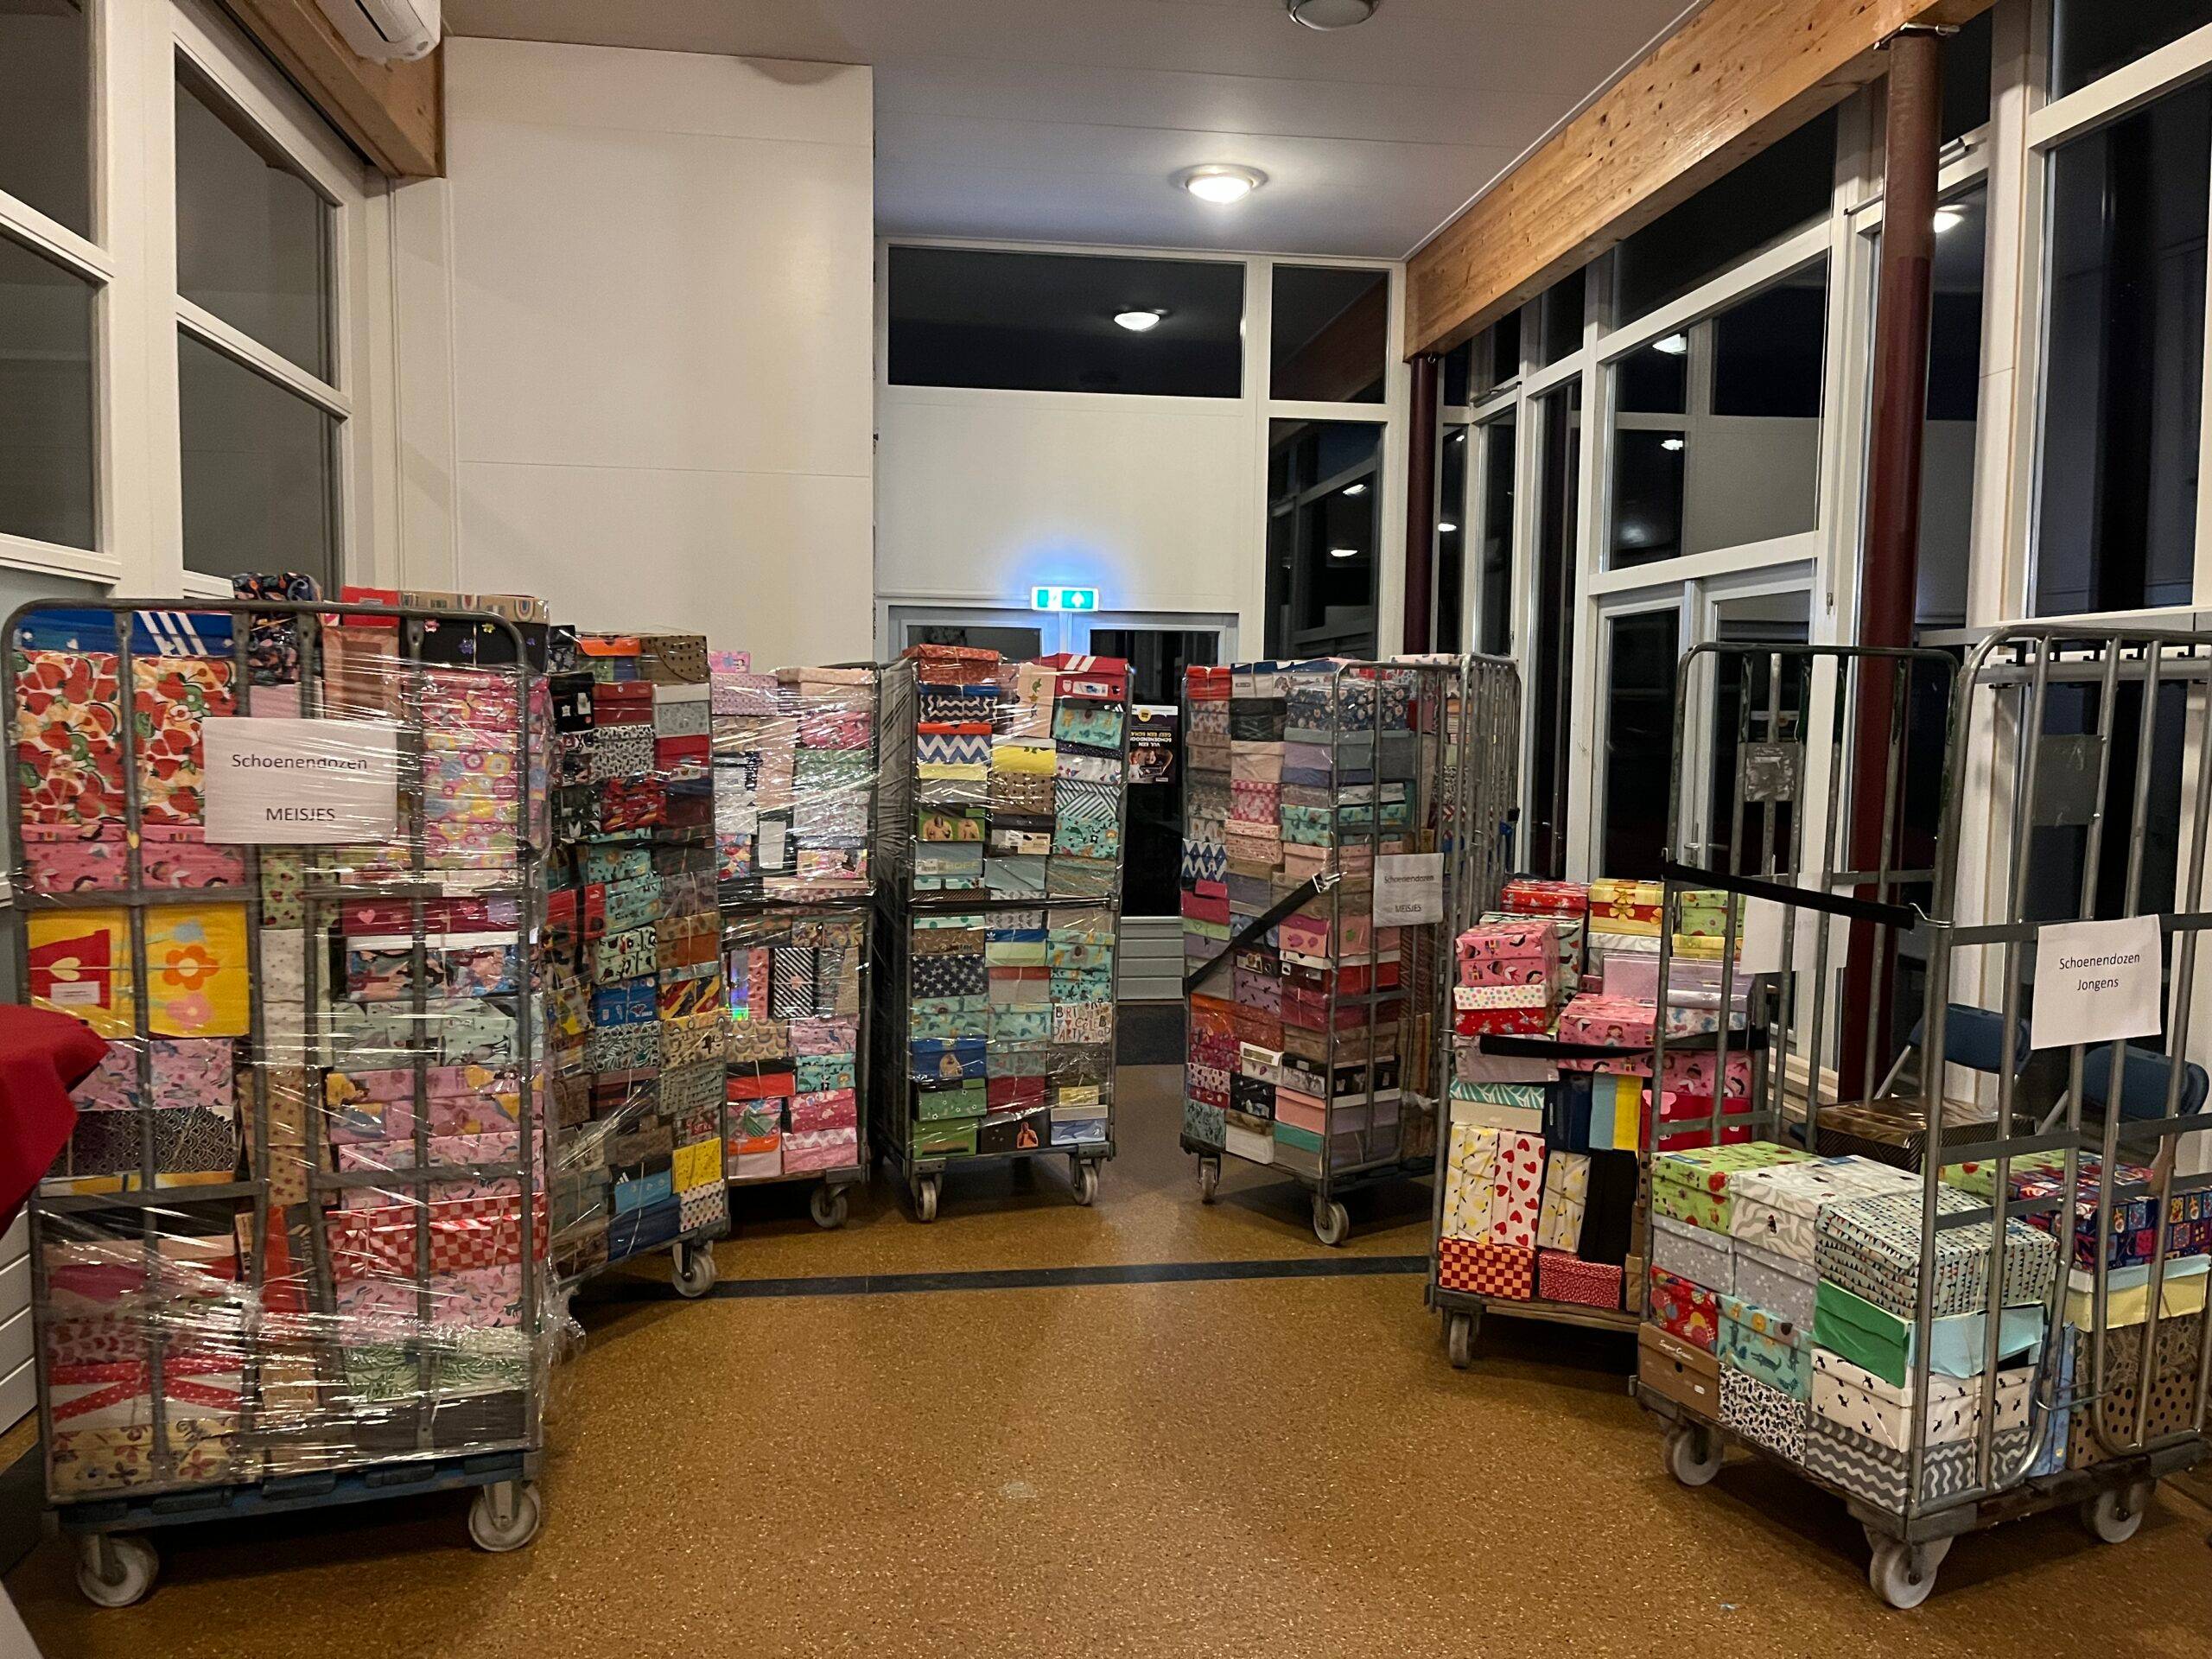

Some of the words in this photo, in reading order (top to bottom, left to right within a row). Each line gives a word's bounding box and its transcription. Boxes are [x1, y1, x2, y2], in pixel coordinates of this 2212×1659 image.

[232, 753, 367, 770] Schoenendozen
[266, 808, 335, 821] MEISJES
[1395, 904, 1422, 912] MEISJES
[2059, 953, 2140, 969] Schoenendozen
[2077, 978, 2119, 992] Jongens
